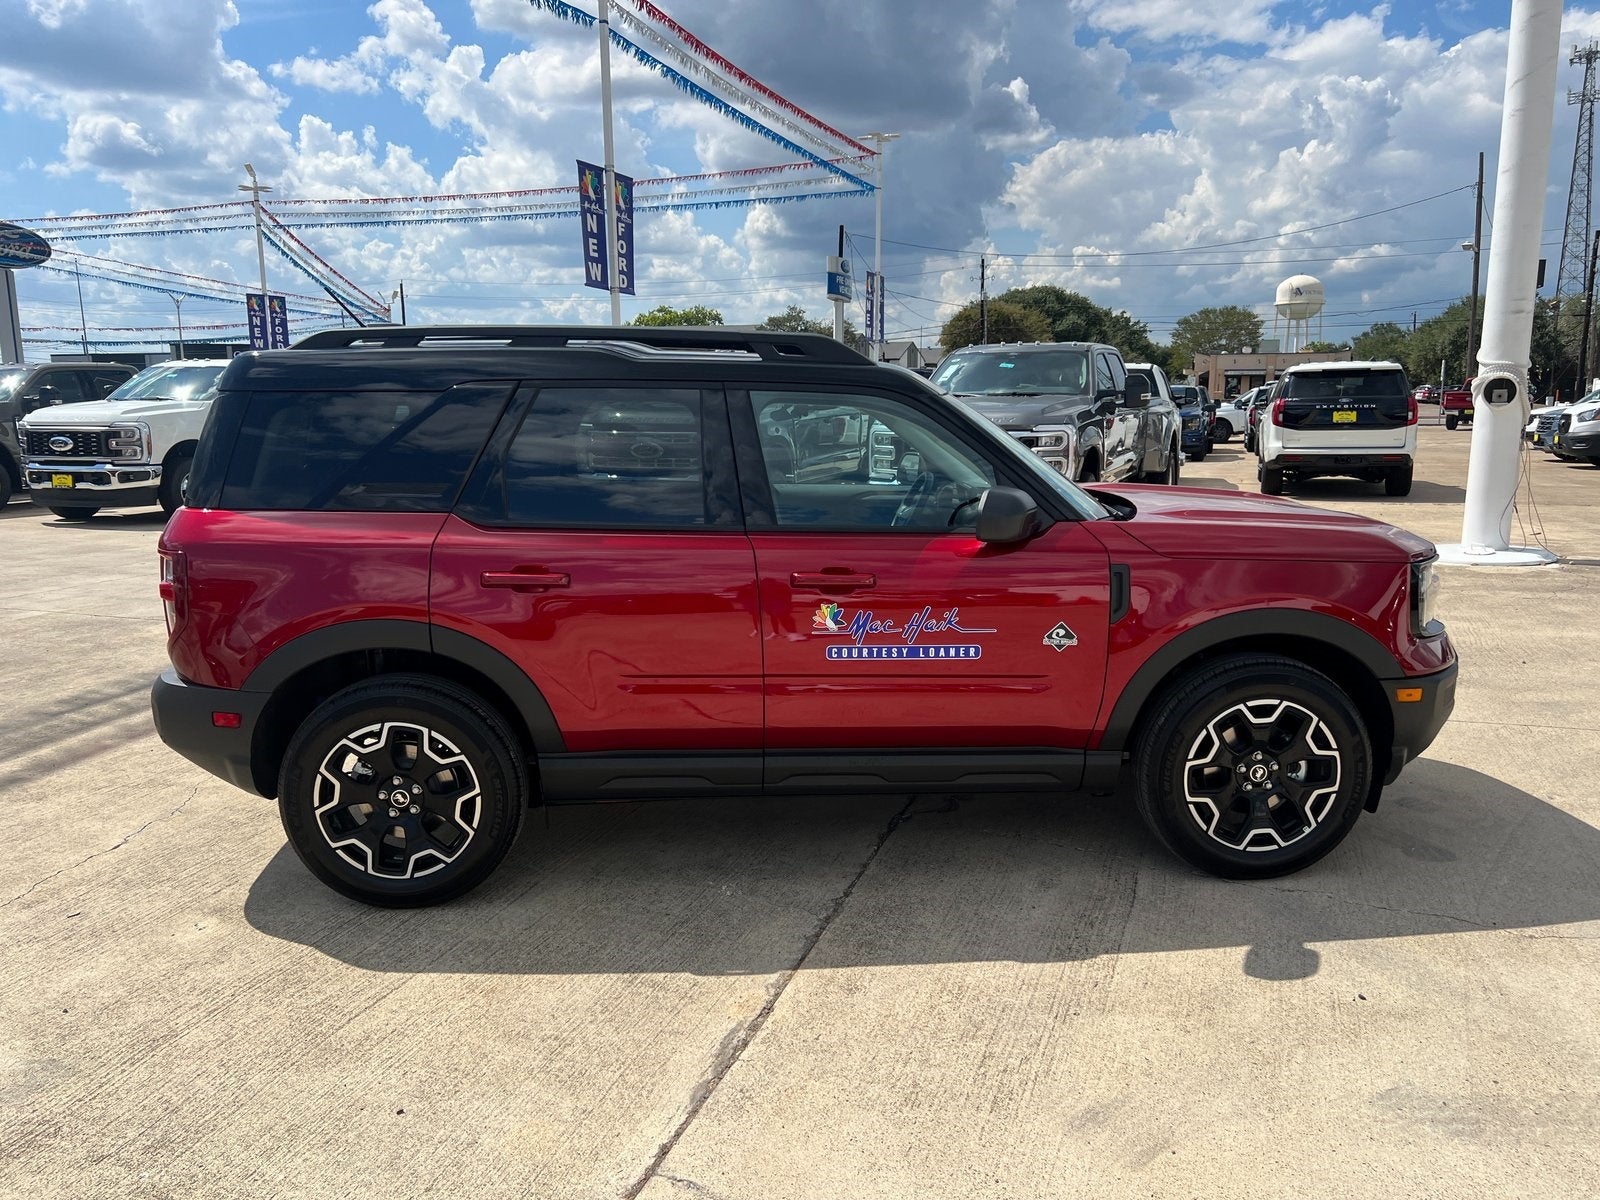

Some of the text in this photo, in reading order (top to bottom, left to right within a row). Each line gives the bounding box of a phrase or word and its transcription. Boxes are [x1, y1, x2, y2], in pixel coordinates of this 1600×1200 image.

[586, 213, 602, 282] NEW
[617, 222, 628, 288] FORD
[252, 316, 264, 348] NEW
[275, 318, 285, 349] FORD
[849, 606, 996, 646] Mac Haik
[831, 647, 976, 658] COURTESY LOANER
